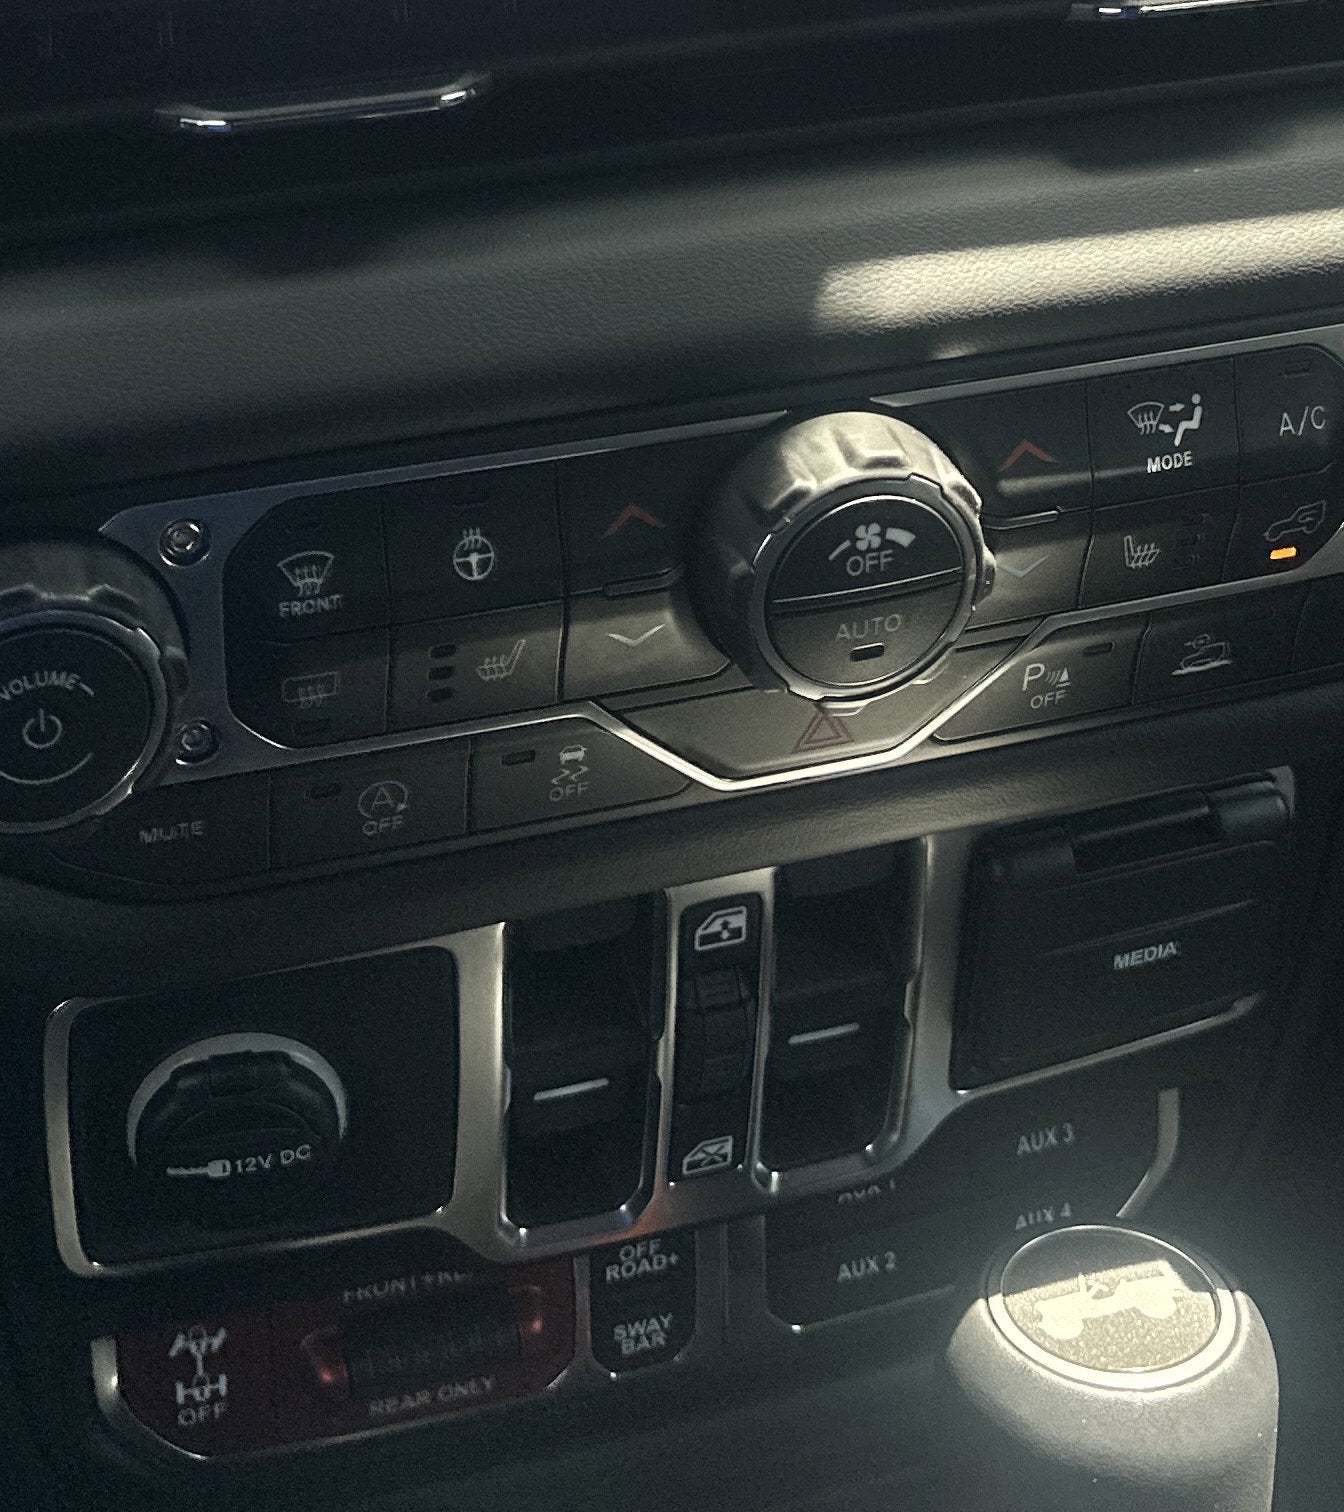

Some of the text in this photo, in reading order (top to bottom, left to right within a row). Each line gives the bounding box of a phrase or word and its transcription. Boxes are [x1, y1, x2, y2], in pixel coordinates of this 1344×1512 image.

[1278, 405, 1327, 437] A/C
[1146, 449, 1194, 474] MODE
[845, 550, 895, 577] OFF
[278, 593, 343, 619] FRONT
[834, 613, 903, 641] AUTO
[1030, 689, 1067, 710] OFF
[548, 781, 591, 802] OFF
[138, 819, 205, 845] MUTE
[361, 815, 405, 837] OFF
[1112, 939, 1179, 970] MEDIA
[1016, 1122, 1076, 1156] AUX 3
[233, 1143, 313, 1175] 12V DC
[1059, 1201, 1073, 1219] 4
[619, 1238, 662, 1262] OFF
[836, 1250, 898, 1283] AUX 2
[613, 1312, 674, 1342] SWAY
[620, 1329, 668, 1356] BAR
[177, 1401, 228, 1428] OFF
